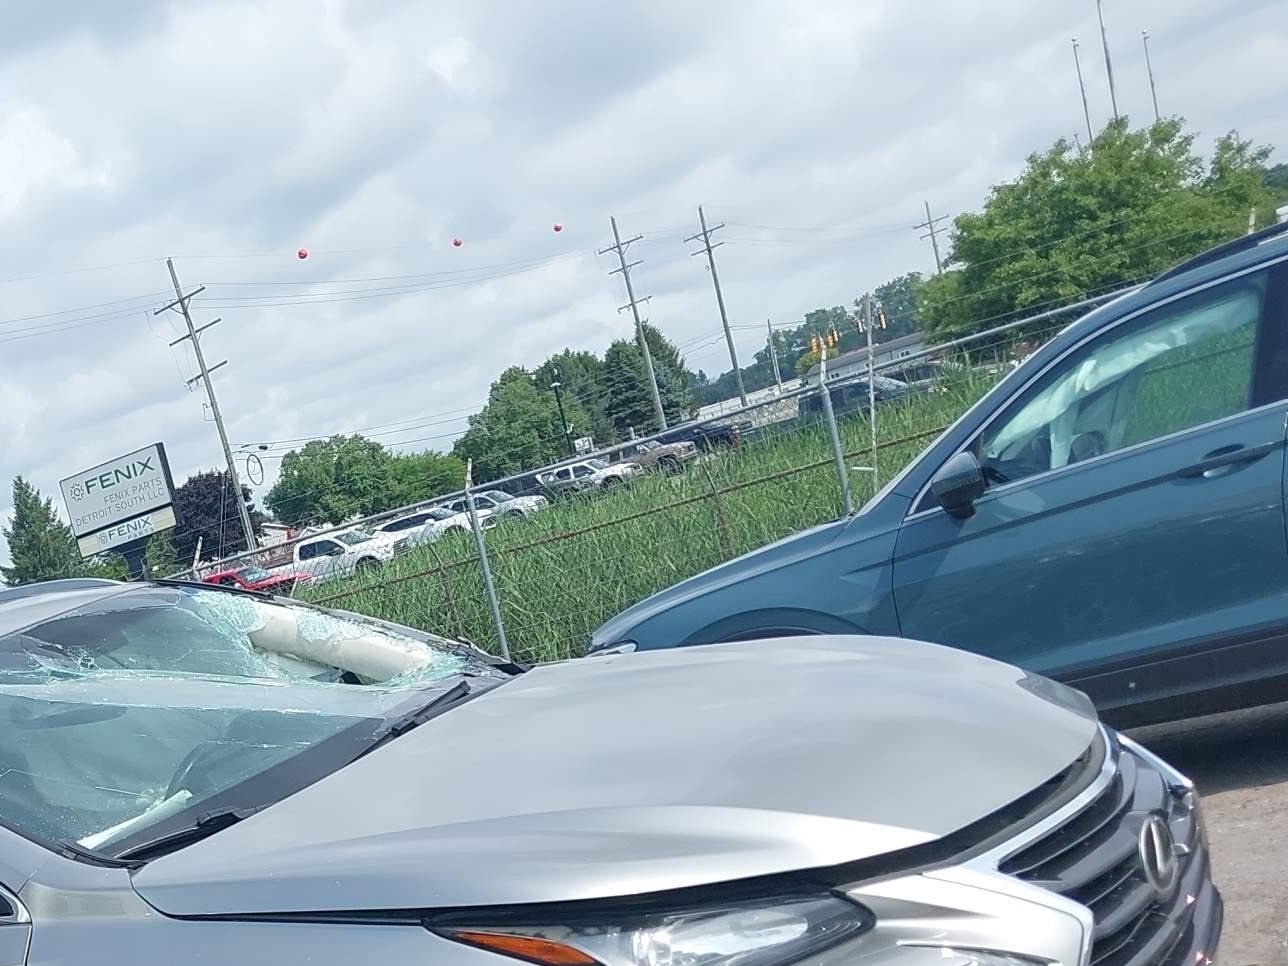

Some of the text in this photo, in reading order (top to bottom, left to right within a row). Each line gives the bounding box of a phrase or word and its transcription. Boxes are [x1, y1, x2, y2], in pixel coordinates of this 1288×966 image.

[85, 457, 155, 494] FENIX
[103, 477, 162, 505] FENIX PARTS
[76, 487, 165, 527] DETROIT SOUTH LLC
[108, 516, 152, 540] FENIX
